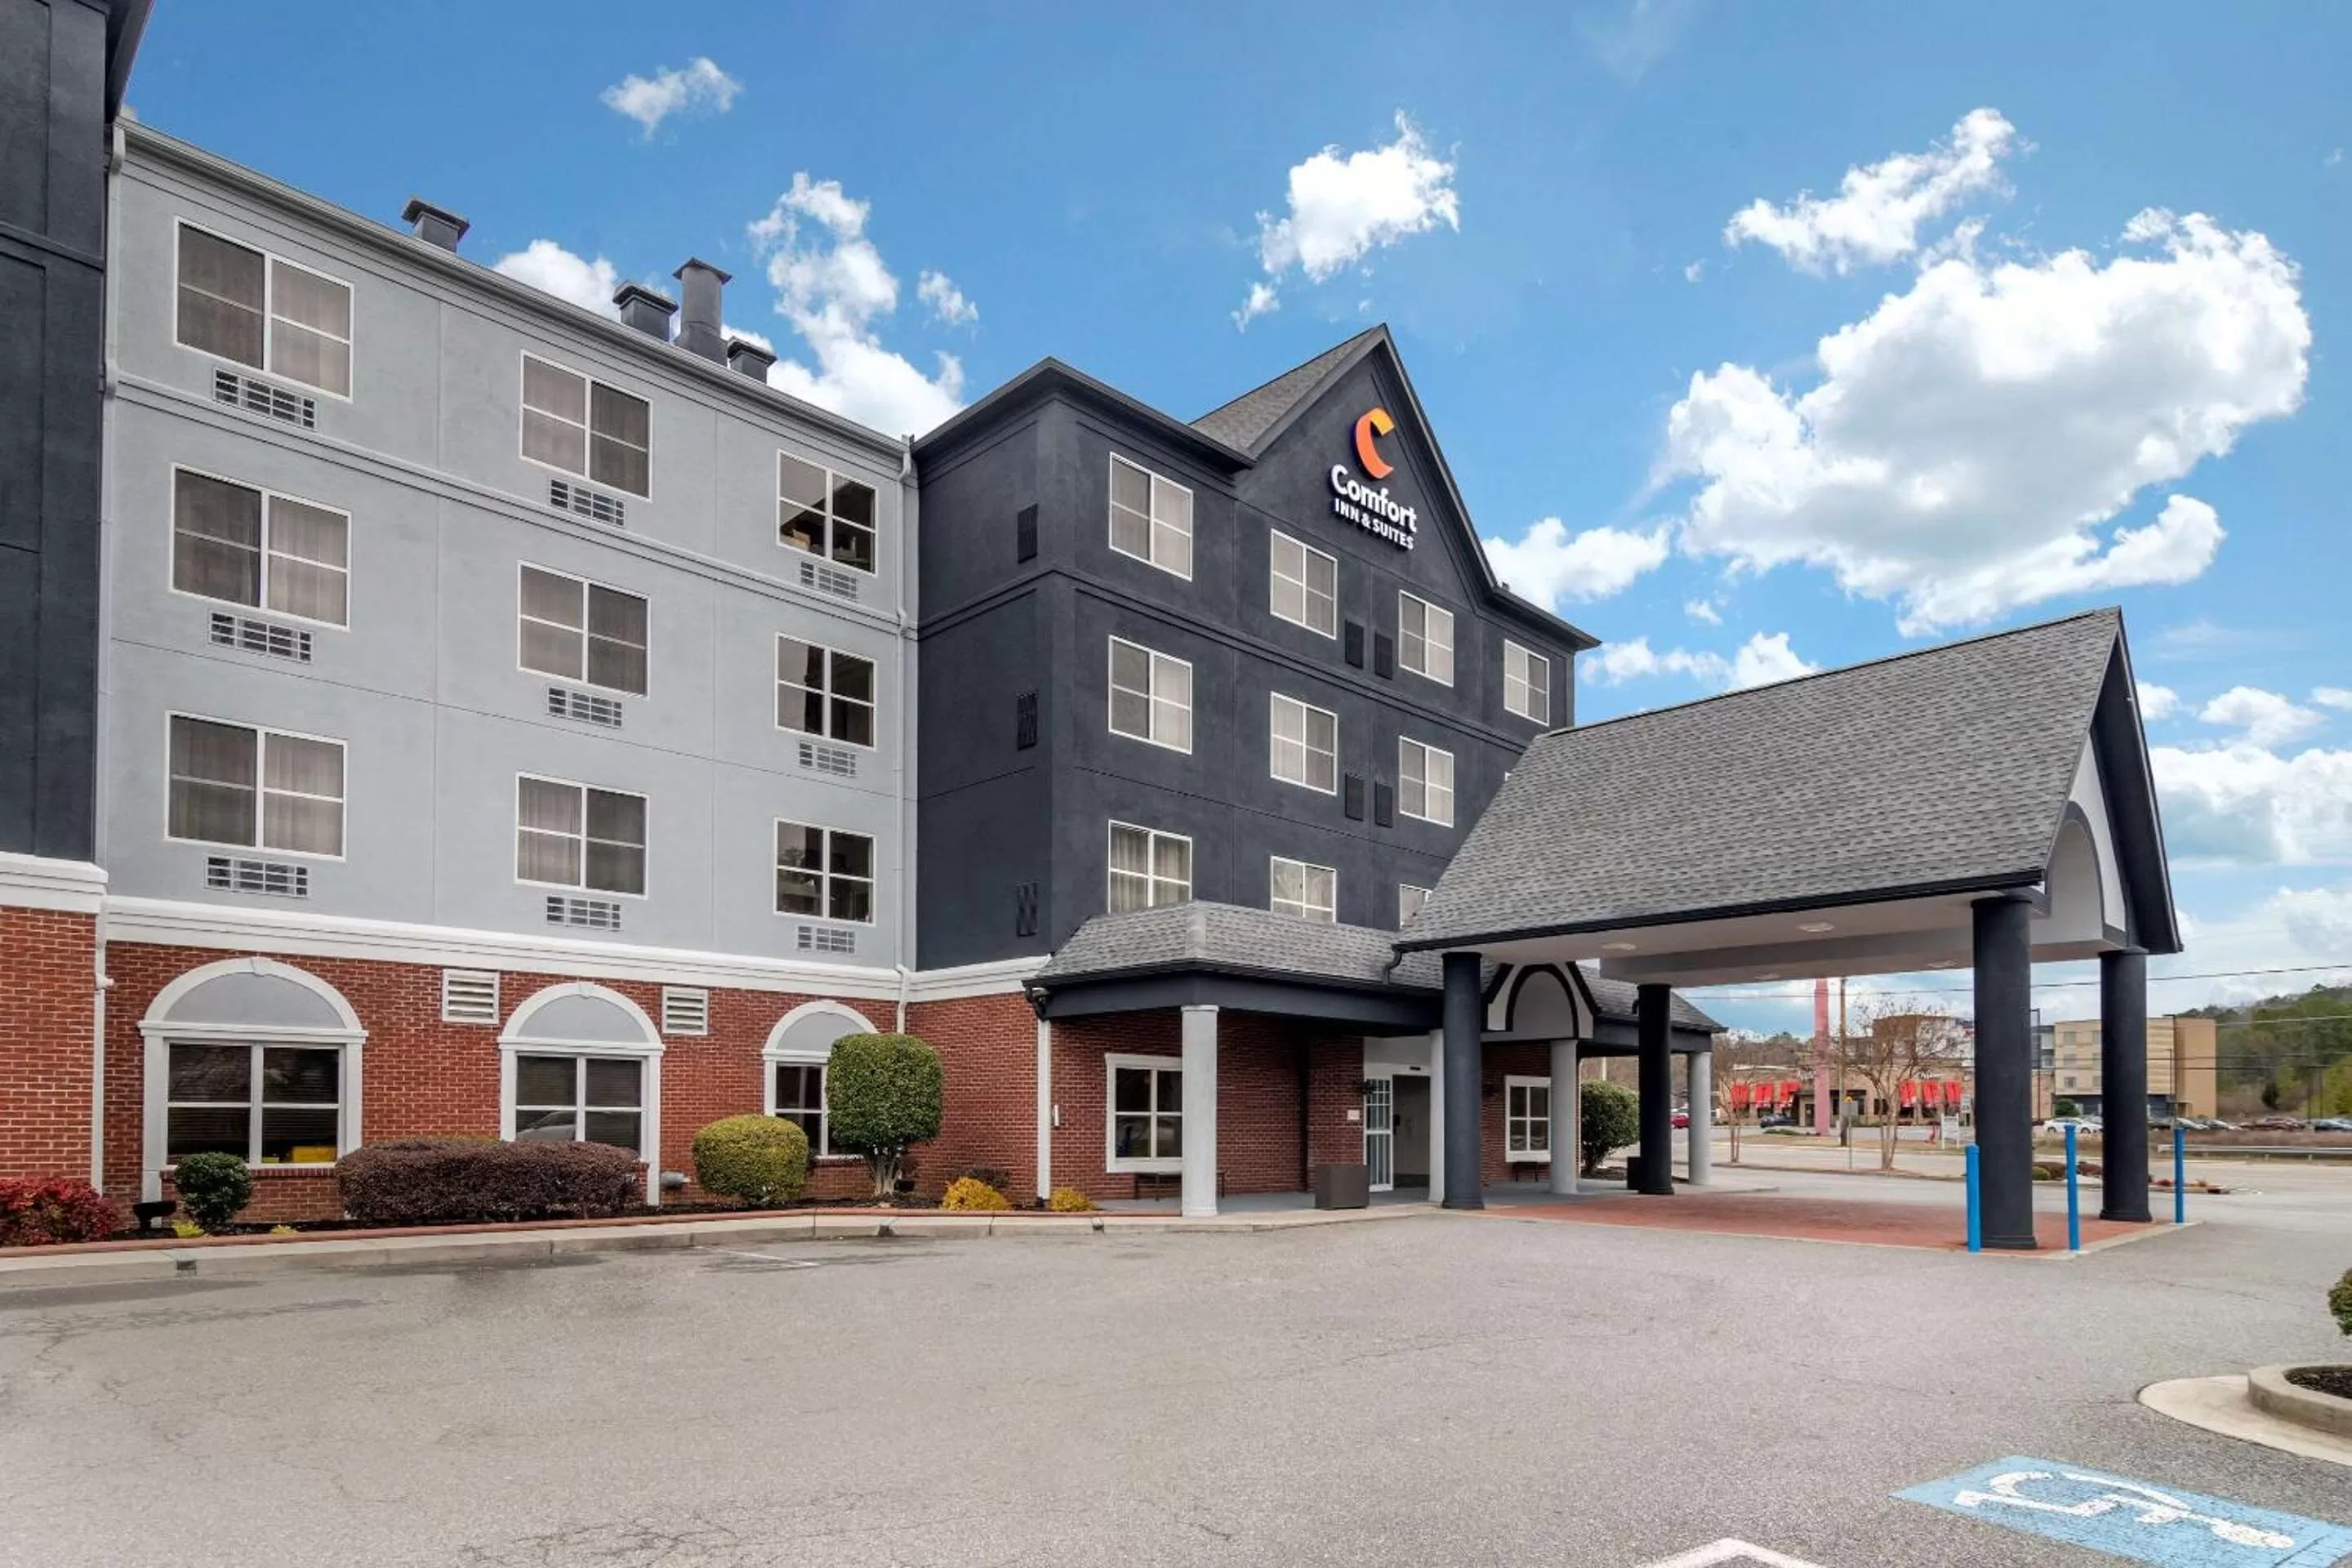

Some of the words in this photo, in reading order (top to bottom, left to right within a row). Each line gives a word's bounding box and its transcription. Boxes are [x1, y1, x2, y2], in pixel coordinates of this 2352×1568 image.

[1330, 464, 1418, 533] Comfort
[1334, 498, 1360, 523] INN
[1361, 512, 1371, 529] &
[1372, 518, 1414, 550] SUITES
